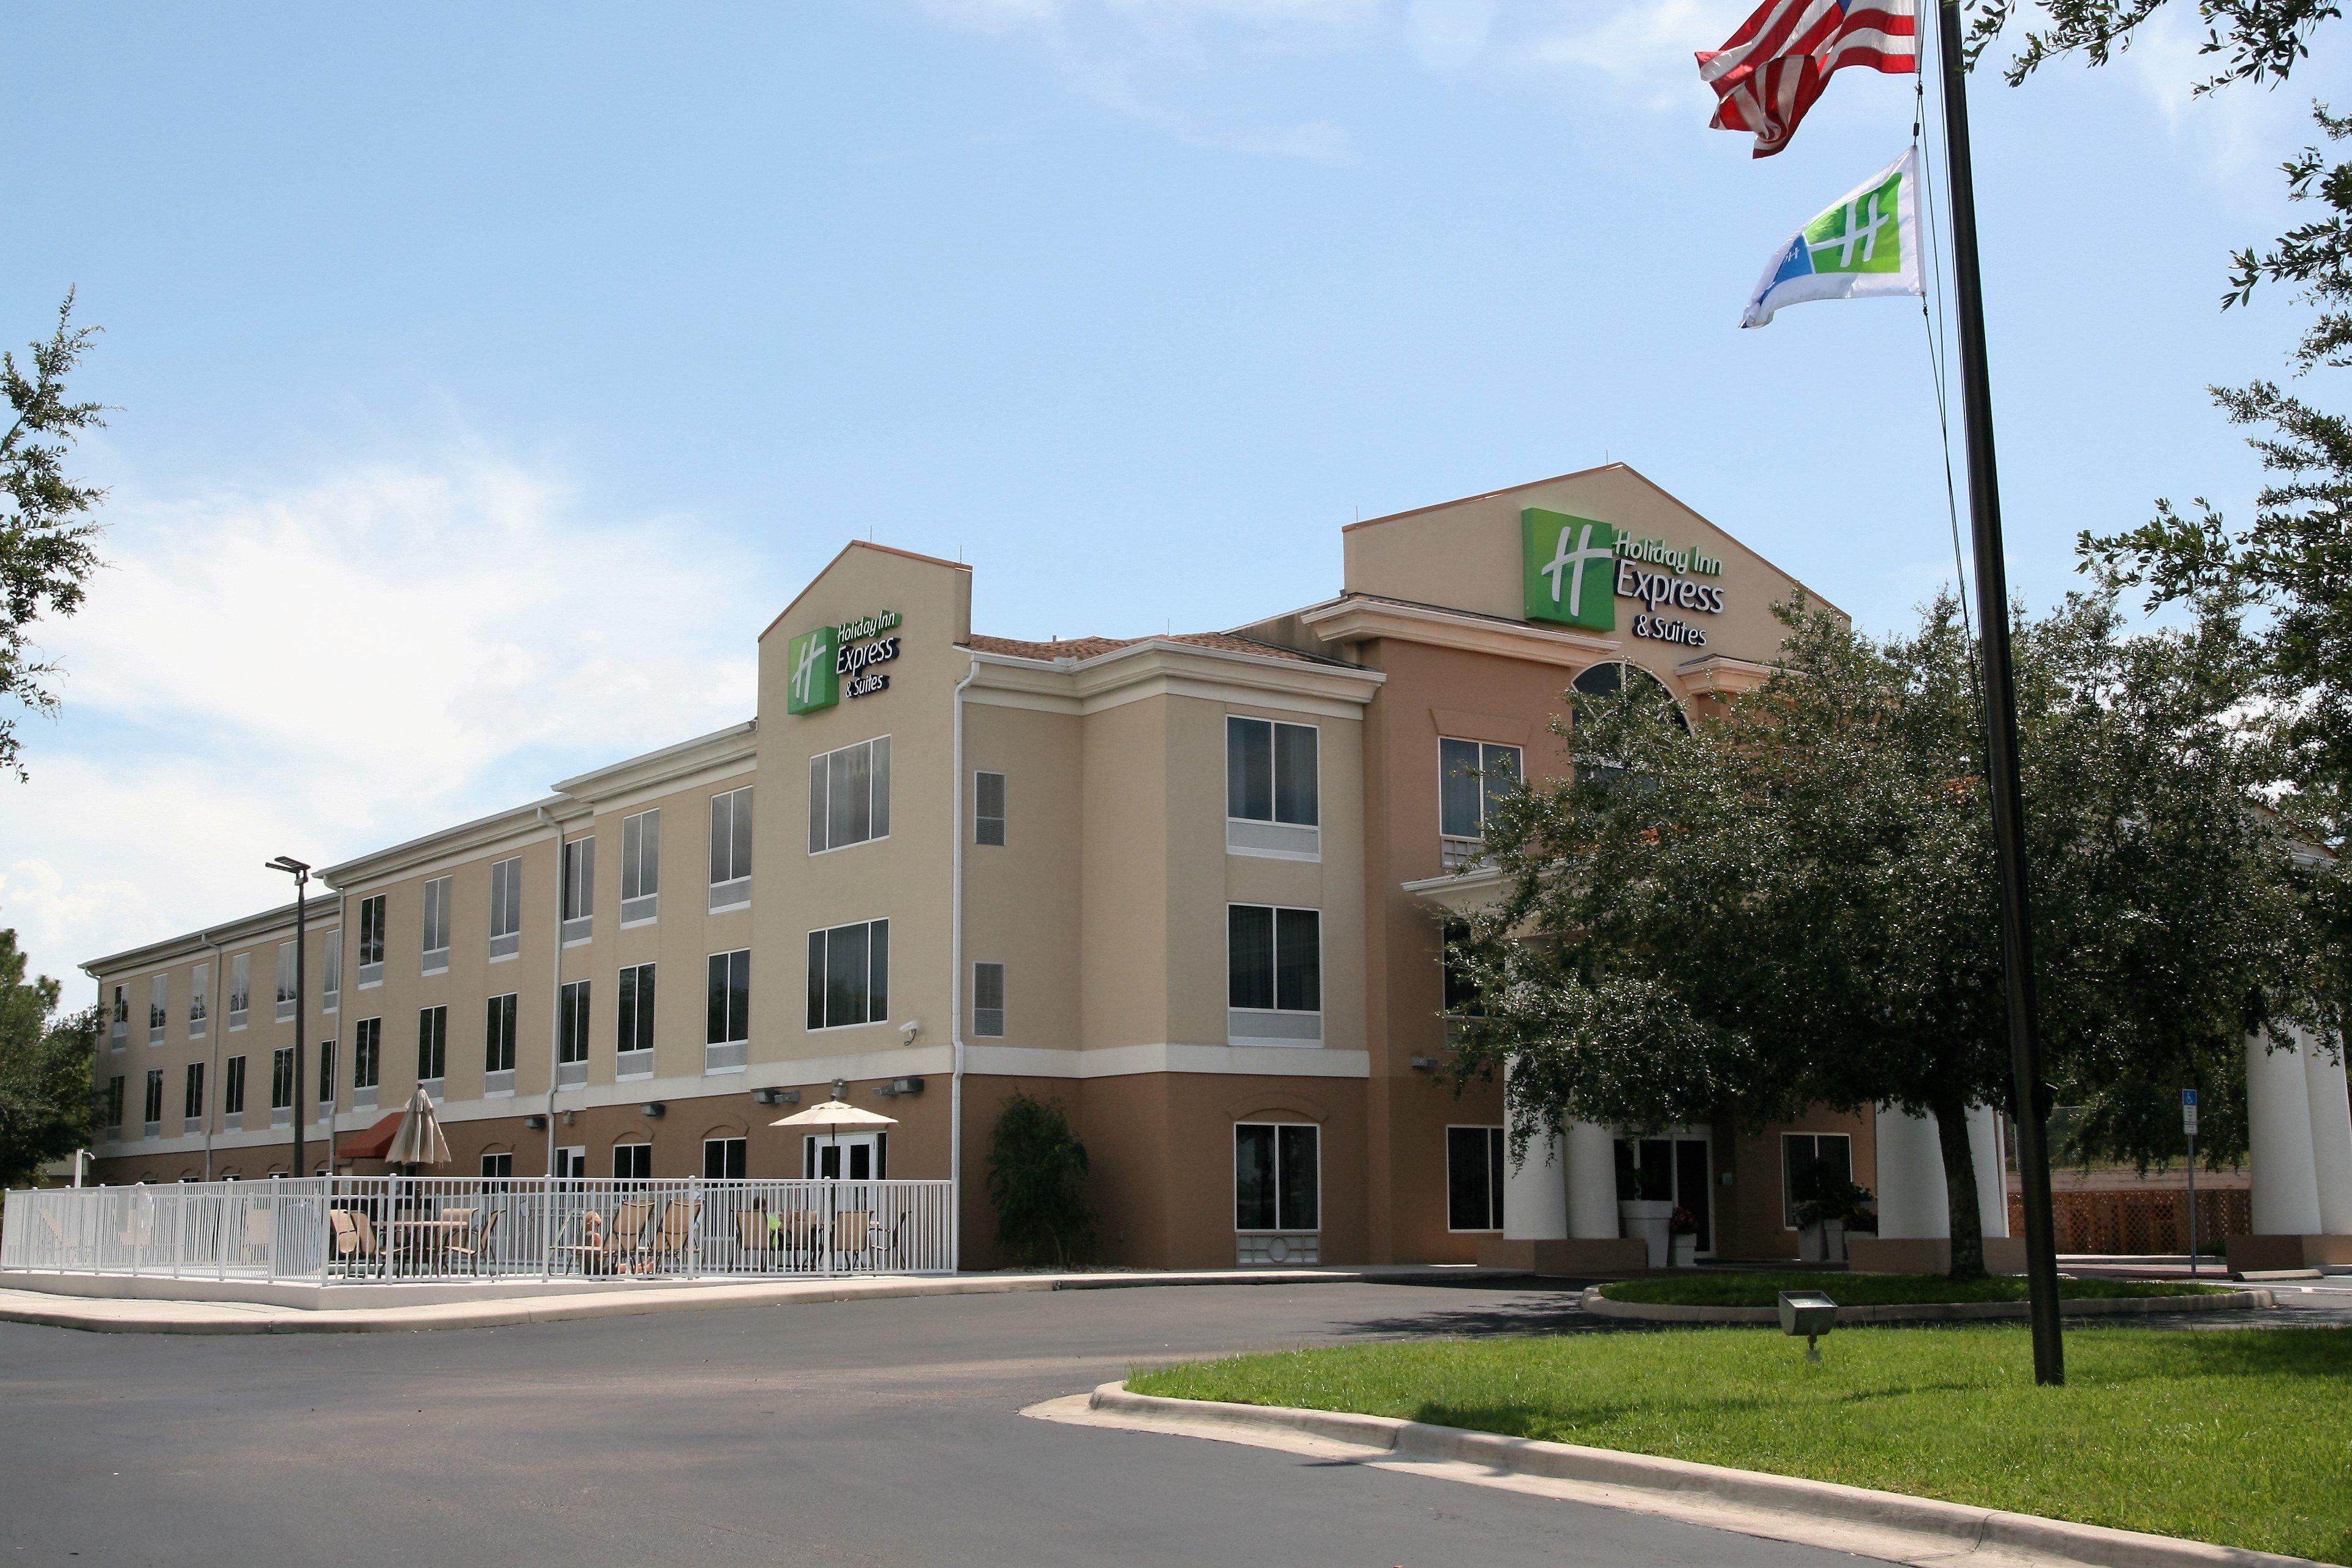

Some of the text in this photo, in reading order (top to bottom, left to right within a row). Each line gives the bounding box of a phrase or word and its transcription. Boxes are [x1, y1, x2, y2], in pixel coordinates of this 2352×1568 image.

[1541, 524, 1613, 617] H
[1612, 529, 1723, 576] Holiday Inn
[1616, 558, 1725, 613] Express
[836, 610, 896, 643] Holiday Inn
[1636, 614, 1707, 647] & Suites
[792, 633, 827, 703] H
[836, 637, 895, 677] Express
[845, 675, 884, 698] & Suites
